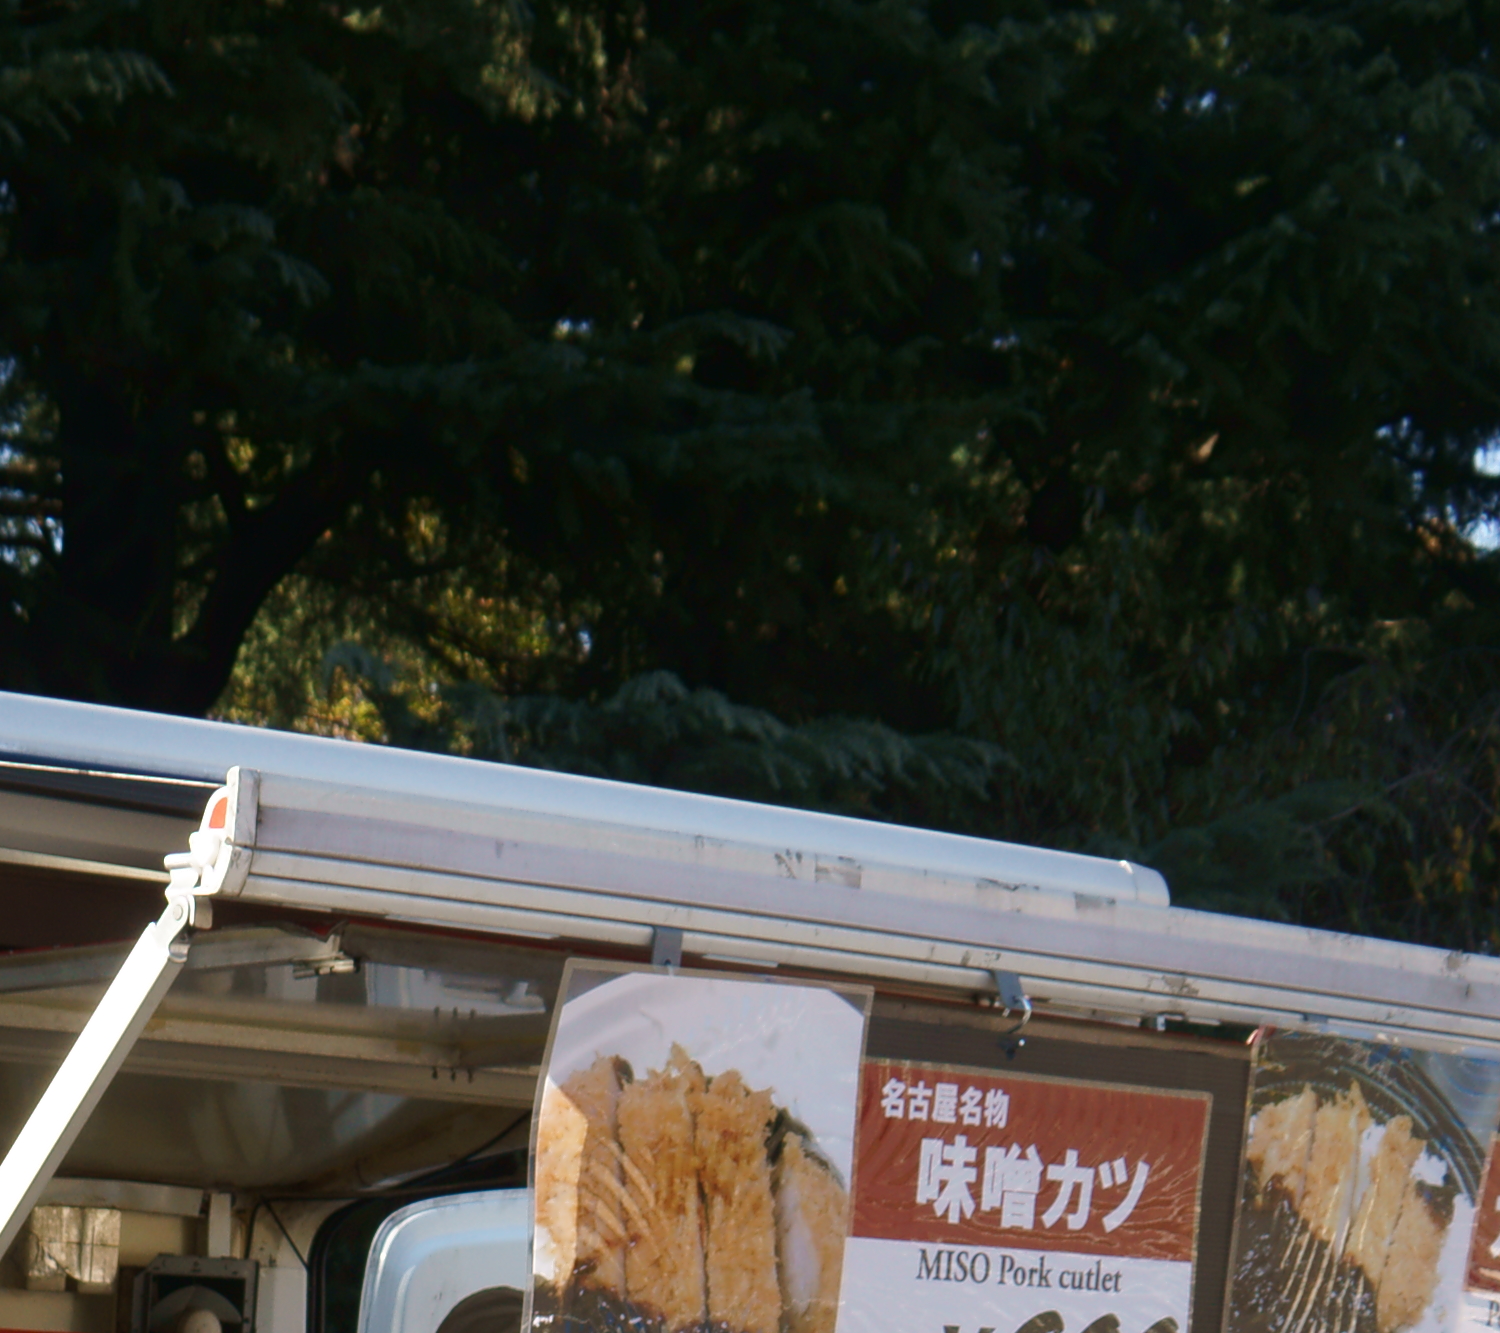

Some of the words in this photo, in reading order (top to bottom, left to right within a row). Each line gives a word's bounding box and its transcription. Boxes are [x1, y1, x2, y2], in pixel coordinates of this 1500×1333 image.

[881, 1077, 1009, 1128] 名古屋名物
[916, 1135, 1149, 1234] 味噌カツ
[917, 1248, 990, 1284] MISO
[998, 1255, 1052, 1290] Pork
[1058, 1259, 1122, 1293] cutlet
